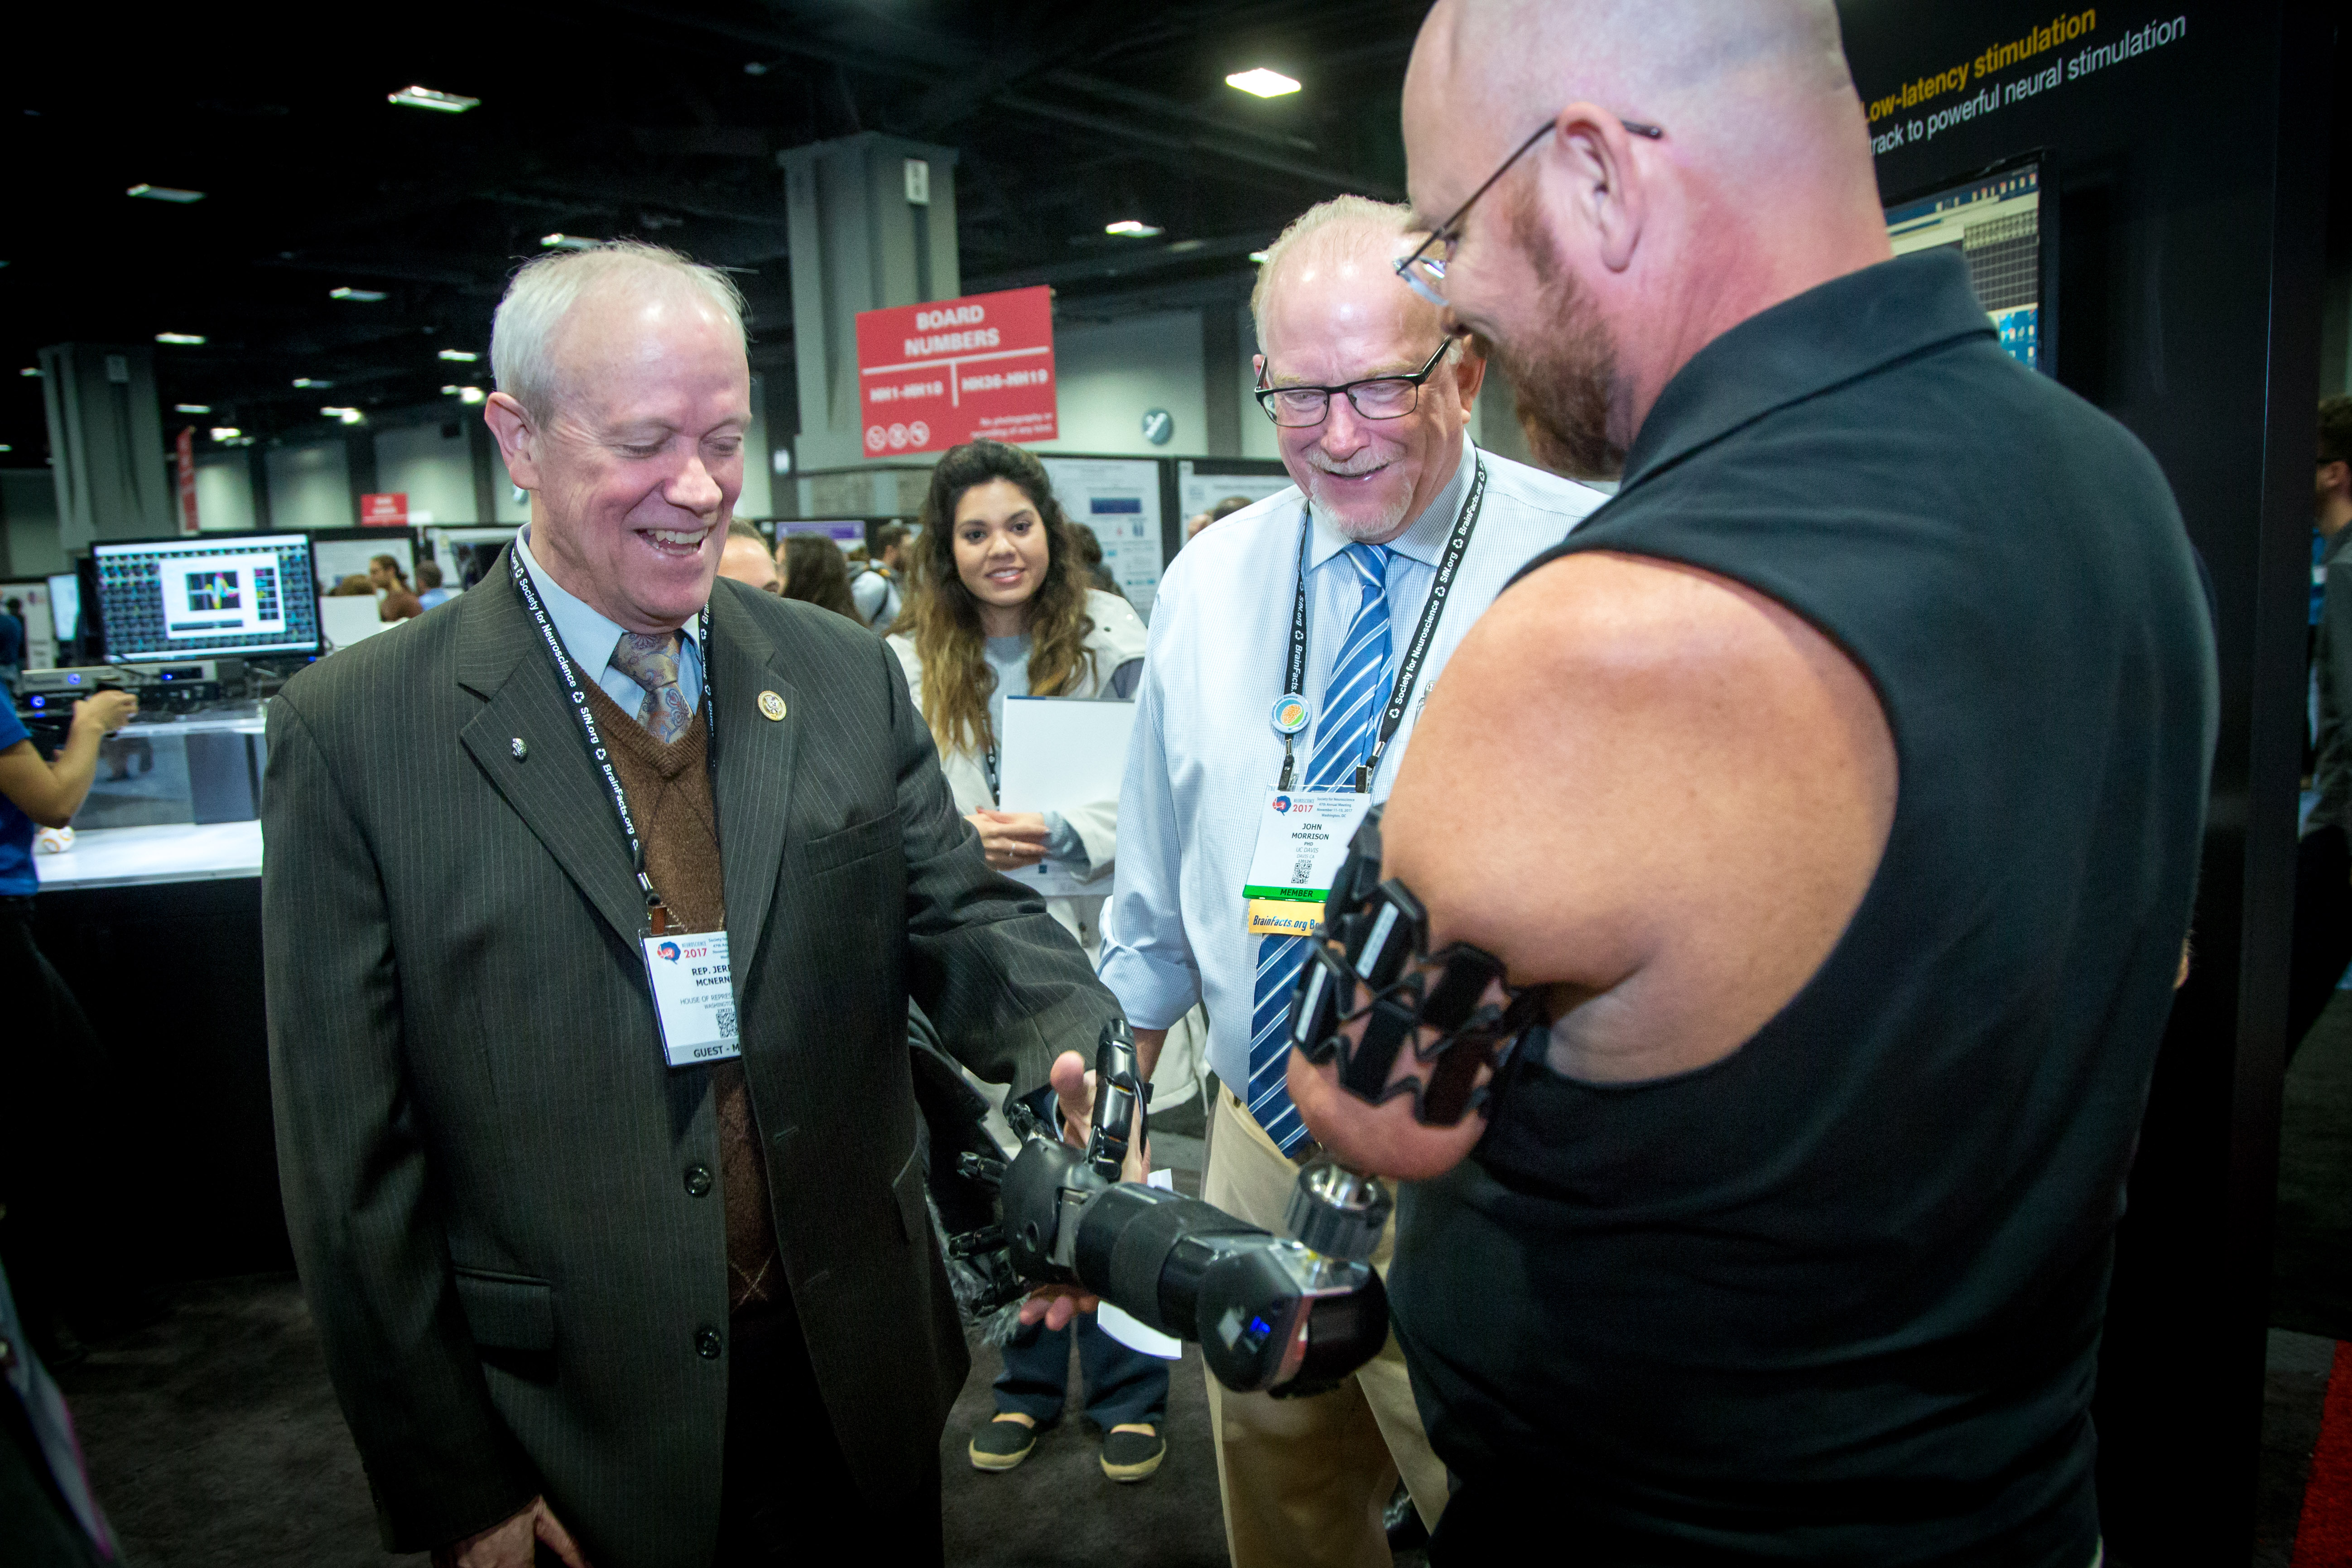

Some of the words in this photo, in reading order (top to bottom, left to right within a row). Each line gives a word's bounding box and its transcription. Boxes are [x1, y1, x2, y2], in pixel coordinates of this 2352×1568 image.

[1974, 9, 2096, 78] stimulation
[1871, 123, 1904, 156] rack
[1907, 119, 1924, 142] to
[1927, 83, 2000, 141] powerful
[2005, 58, 2062, 105] neural
[2068, 15, 2186, 81] stimulation
[916, 305, 984, 331] BOARD
[904, 327, 1000, 356] NUMBERS
[1458, 481, 1483, 535] BrainFacts.org
[1440, 551, 1458, 583] SfN.org
[1296, 595, 1304, 627] SfN.org
[520, 578, 539, 611] Society
[535, 610, 546, 624] for
[542, 624, 577, 688] Neuroscience
[1291, 644, 1303, 692] BrainFacts.
[1395, 670, 1413, 705] Society
[1406, 658, 1417, 675] for
[1412, 600, 1439, 658] Neuroscience
[580, 707, 599, 744] SfN.org
[603, 764, 635, 835] BrainFacts.org
[1280, 889, 1313, 897] MEMBER
[1253, 915, 1308, 931] BrainFacts.org
[684, 948, 707, 958] 2017
[692, 967, 711, 976] REP.
[696, 976, 732, 986] MCNERN
[680, 997, 700, 1005] HOUSE
[693, 1045, 723, 1058] GUEST
